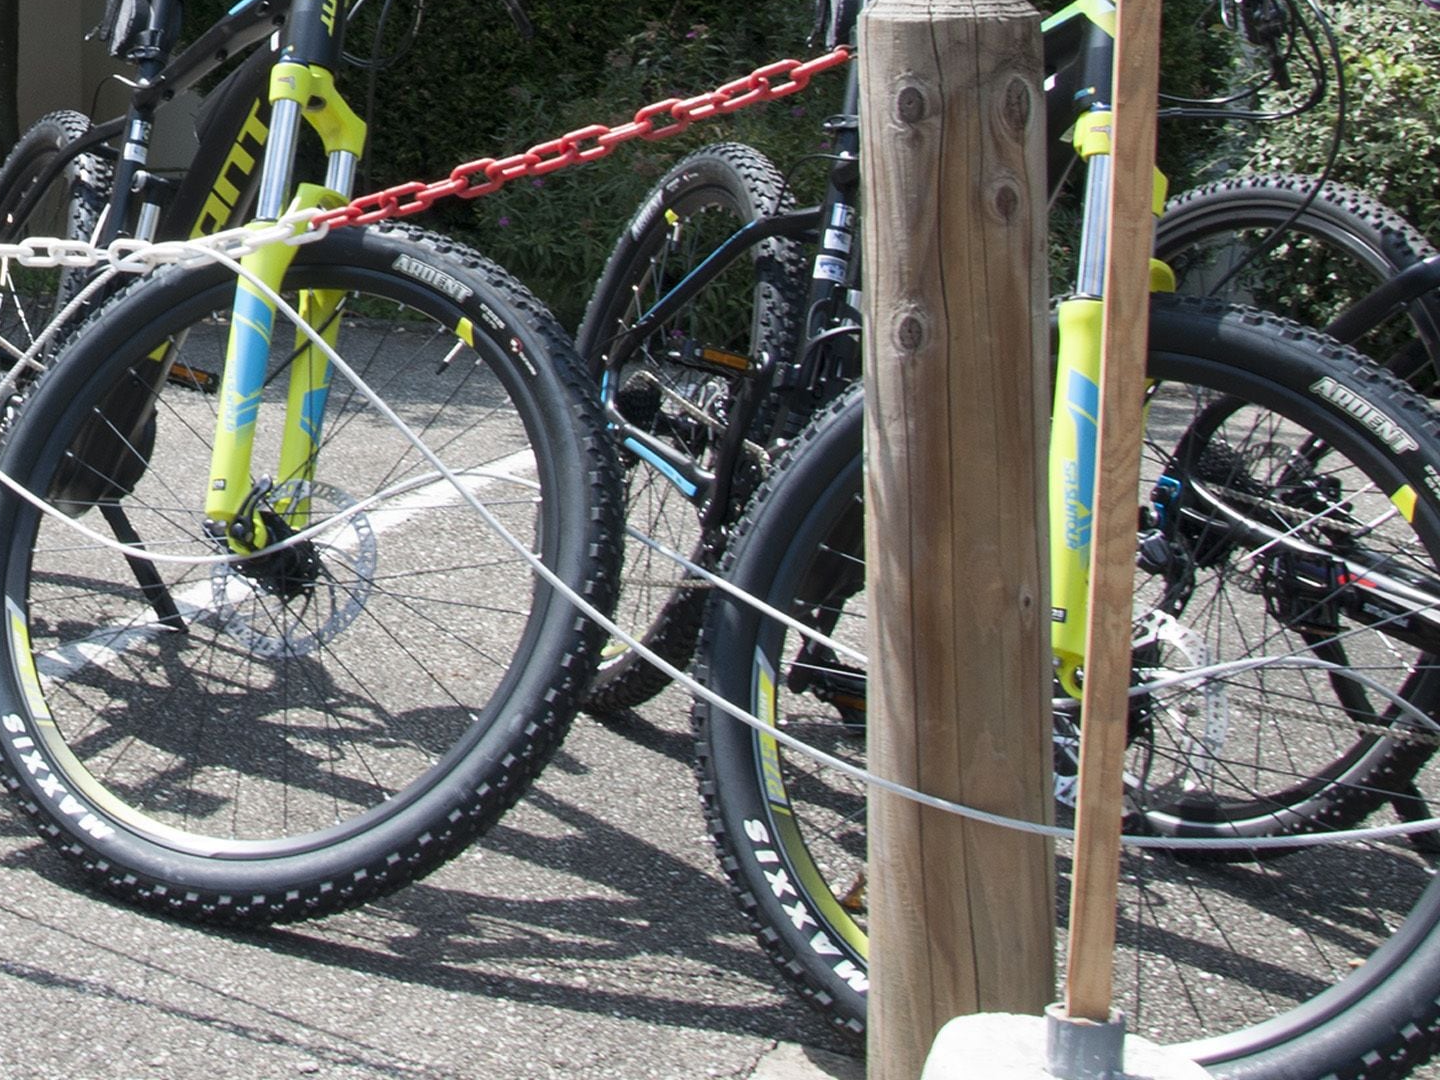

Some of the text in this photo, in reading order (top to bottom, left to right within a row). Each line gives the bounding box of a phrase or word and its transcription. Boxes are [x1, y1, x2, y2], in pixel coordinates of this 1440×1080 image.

[392, 253, 474, 304] ARDENT
[1310, 376, 1419, 454] ARDENT
[2, 713, 115, 839] MAXXIS
[743, 818, 869, 993] MAXXIS
